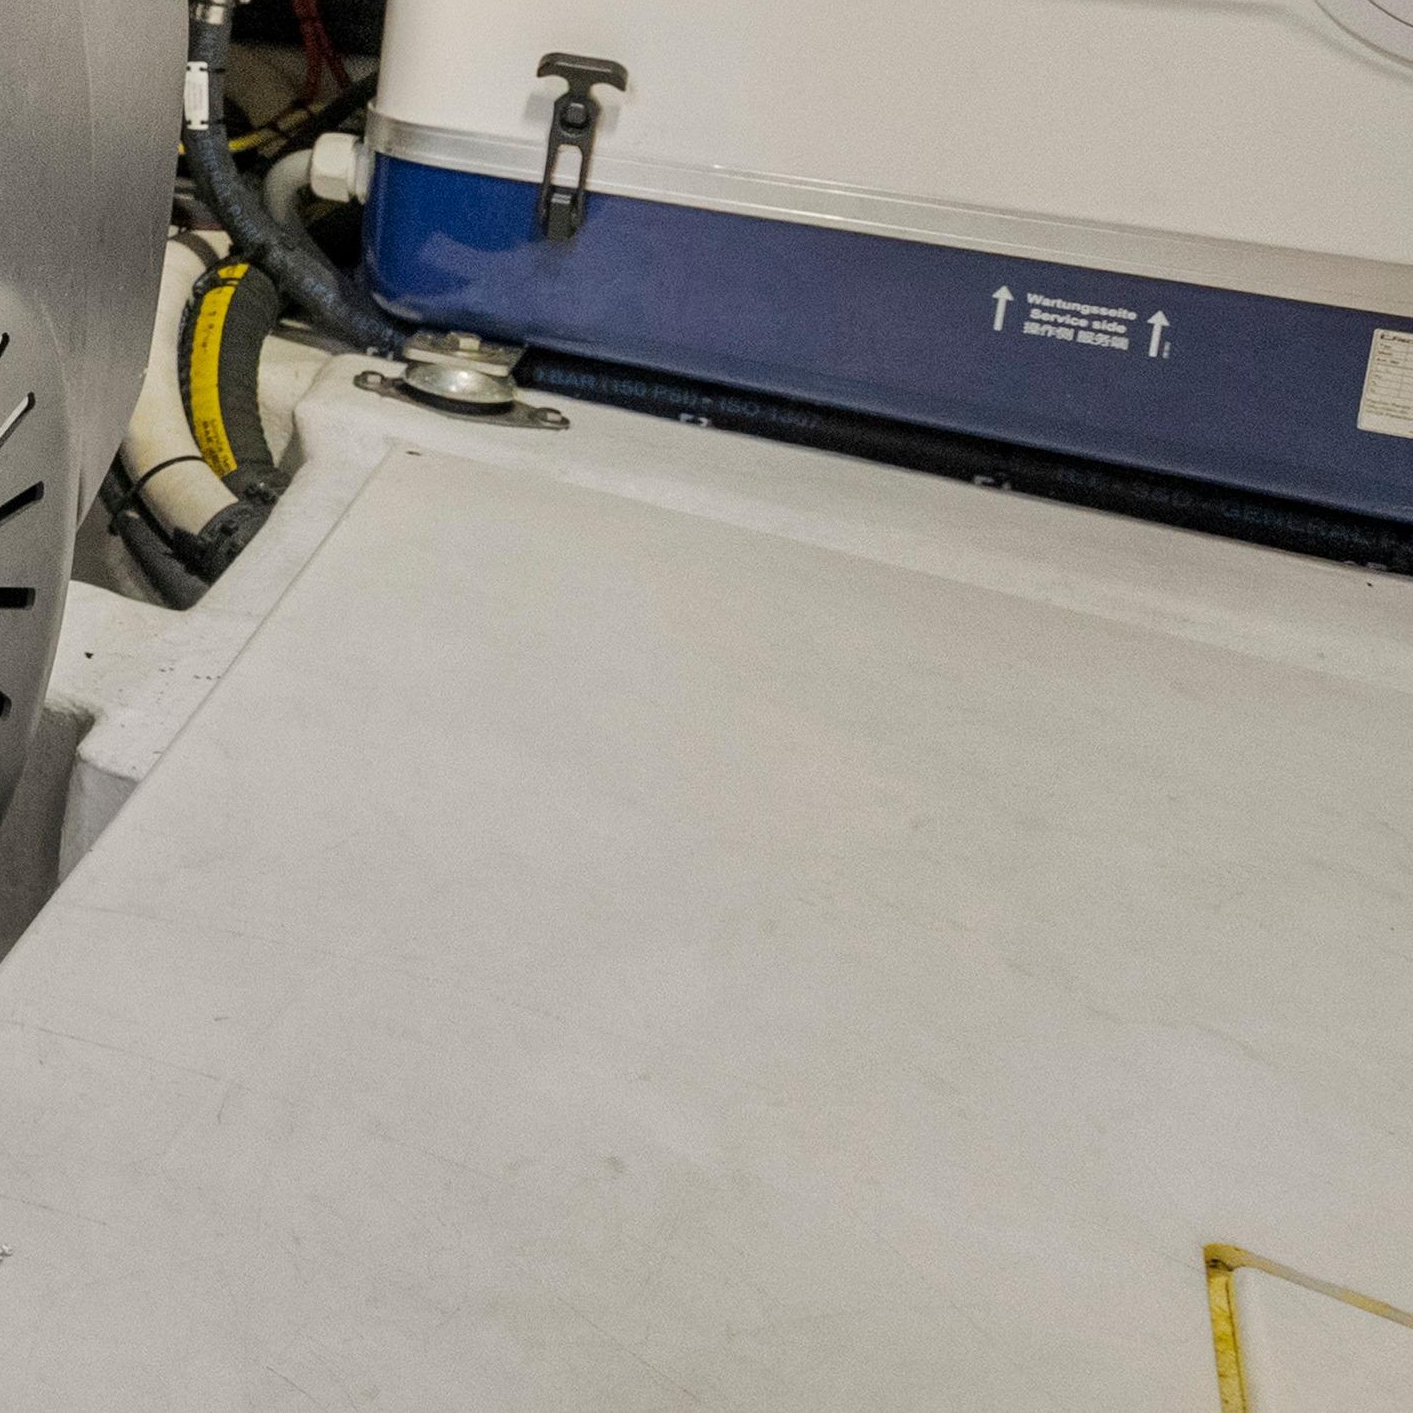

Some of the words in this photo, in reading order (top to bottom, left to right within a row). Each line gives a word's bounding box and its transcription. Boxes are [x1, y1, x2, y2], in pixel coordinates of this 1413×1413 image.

[1027, 292, 1138, 321] Wartungsseite
[1029, 308, 1089, 327] Service
[1092, 320, 1127, 334] side
